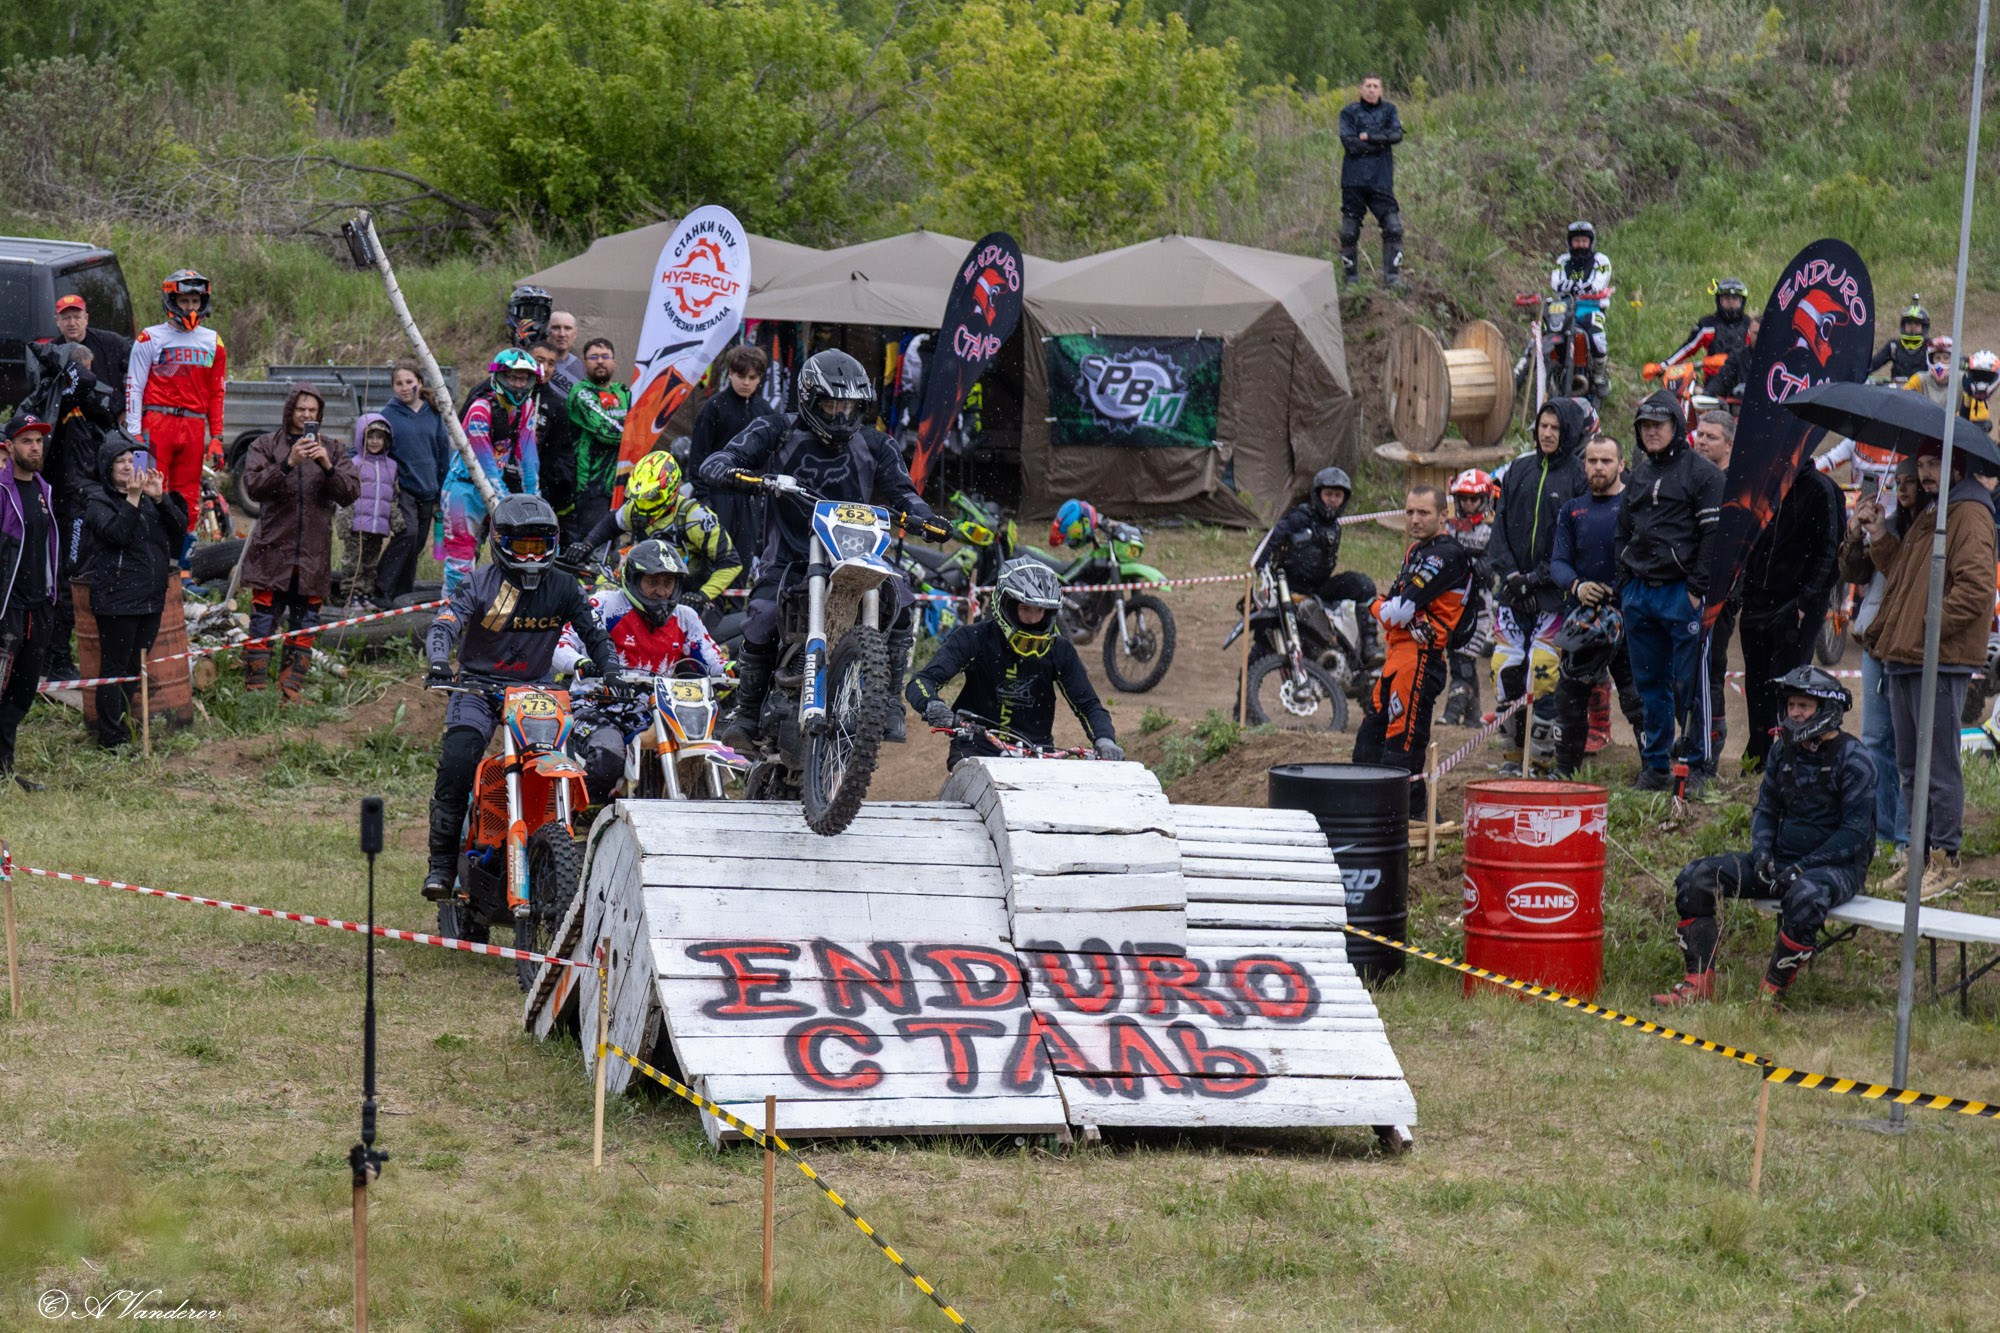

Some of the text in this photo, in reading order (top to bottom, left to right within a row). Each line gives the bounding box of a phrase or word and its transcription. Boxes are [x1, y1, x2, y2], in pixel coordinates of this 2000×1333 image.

[674, 221, 736, 258] СТАНКИ ЧПУ
[661, 270, 741, 295] HYPERCUT
[1777, 258, 1867, 326] ENDURO
[663, 300, 731, 332] ДЛЯ РЕЗКИ МЕТАЛЛА
[164, 349, 208, 362] LEATT
[845, 509, 865, 521] 62
[684, 688, 693, 698] 3
[531, 700, 548, 712] 73
[1509, 894, 1575, 909] SINTEC
[685, 937, 1321, 1025] ENDURO
[784, 1016, 1268, 1100] СТАЛЬ
